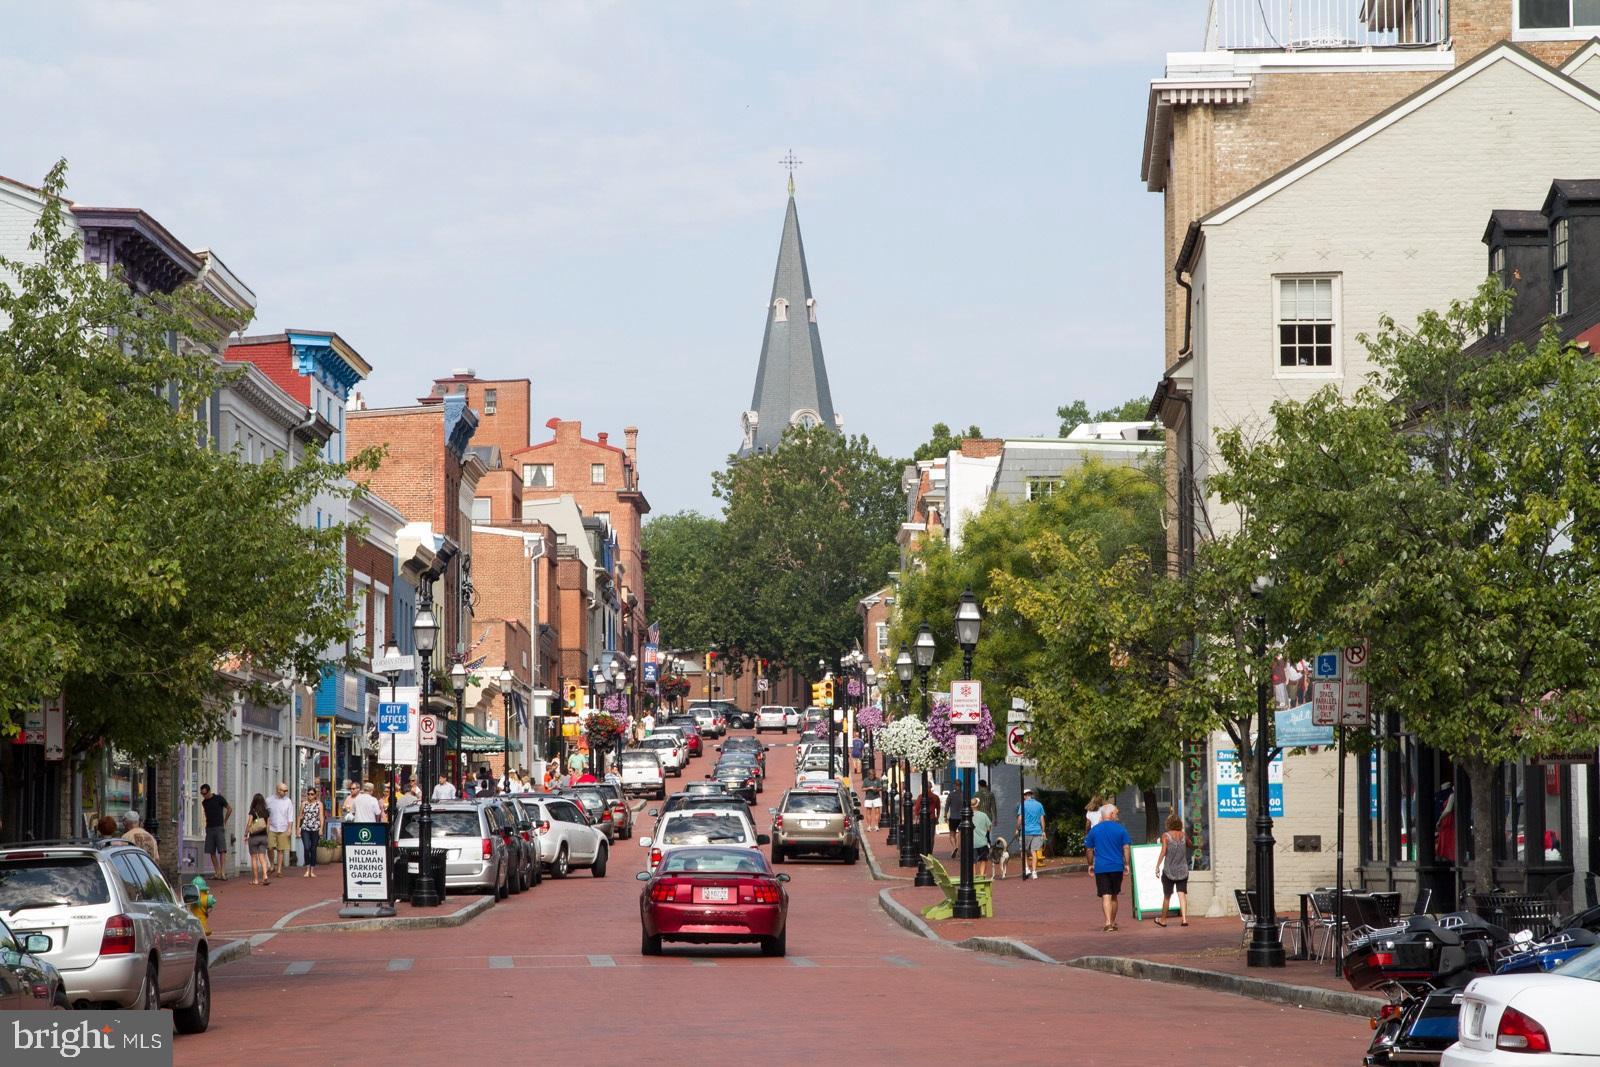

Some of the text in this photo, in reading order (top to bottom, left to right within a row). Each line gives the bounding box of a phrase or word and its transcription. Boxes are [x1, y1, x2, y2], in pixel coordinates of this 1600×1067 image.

[386, 705, 401, 714] CITY
[381, 715, 407, 724] OFFICES
[1541, 752, 1566, 761] Coffee
[354, 848, 378, 856] NOAH
[348, 856, 384, 864] HILLMAN
